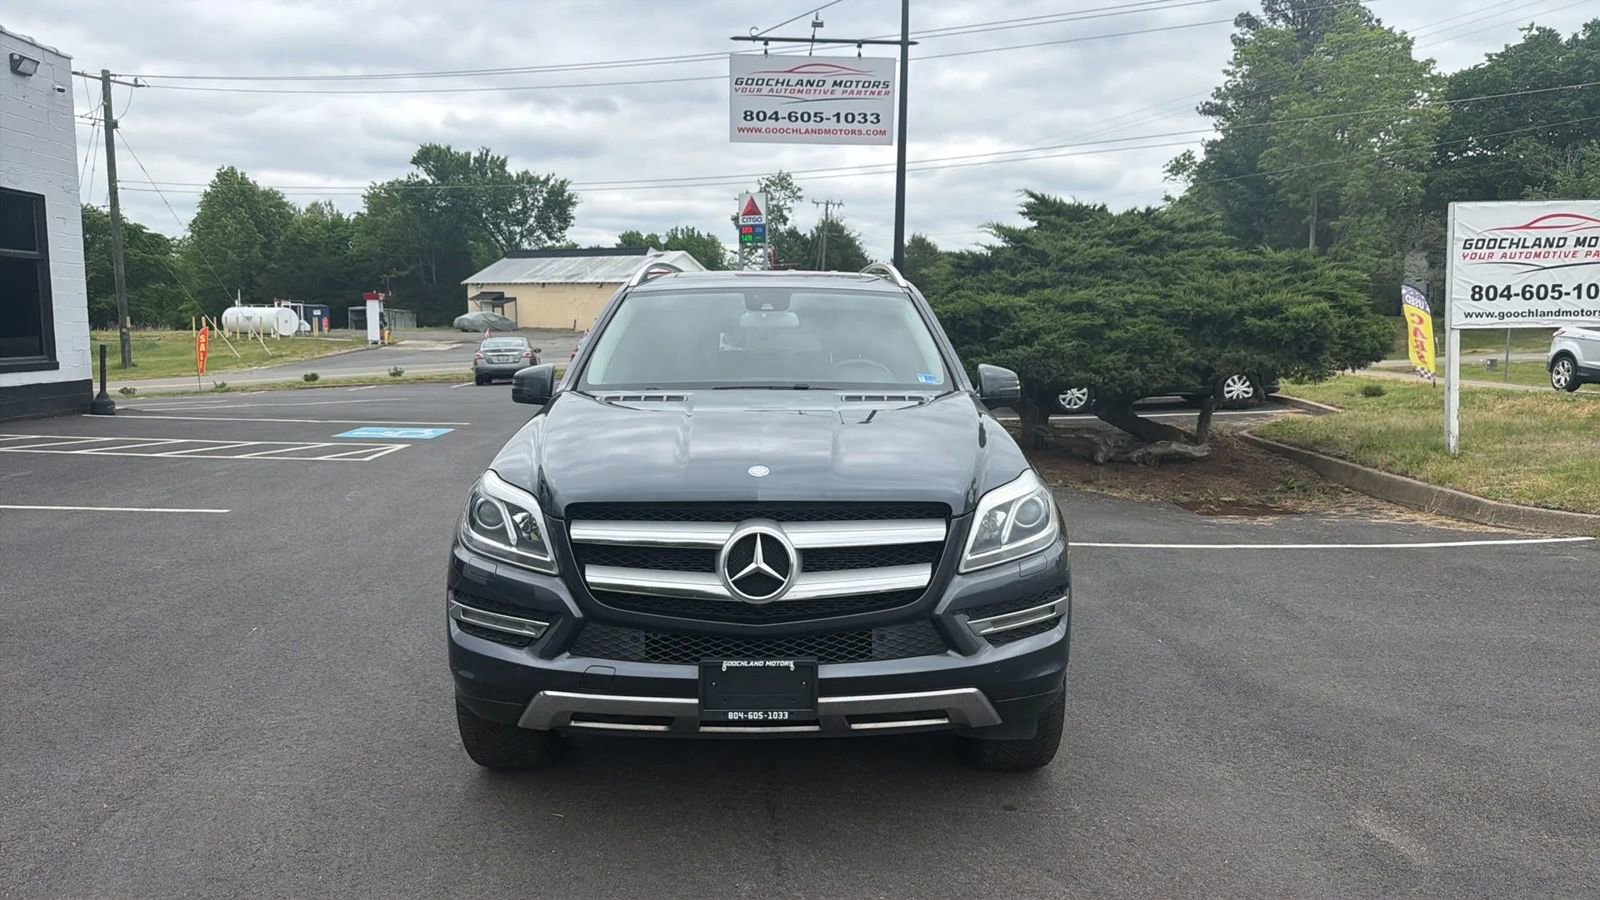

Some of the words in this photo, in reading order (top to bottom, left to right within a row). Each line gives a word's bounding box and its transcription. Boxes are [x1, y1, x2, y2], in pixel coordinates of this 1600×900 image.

[734, 77, 826, 88] GOOCHLAND
[832, 80, 890, 89] MOTORS
[768, 87, 836, 96] AUTOMOTIVE
[841, 89, 891, 97] PARTNER
[742, 110, 881, 125] 804-605-1033
[737, 126, 887, 136] WWW.GOOCHLANDMOTORS.COM
[1462, 236, 1568, 250] GOOCHLAND
[1461, 252, 1495, 260] YOUR
[1499, 250, 1579, 260] AUTOMOTIVE
[727, 711, 789, 720] 804-605-1033
